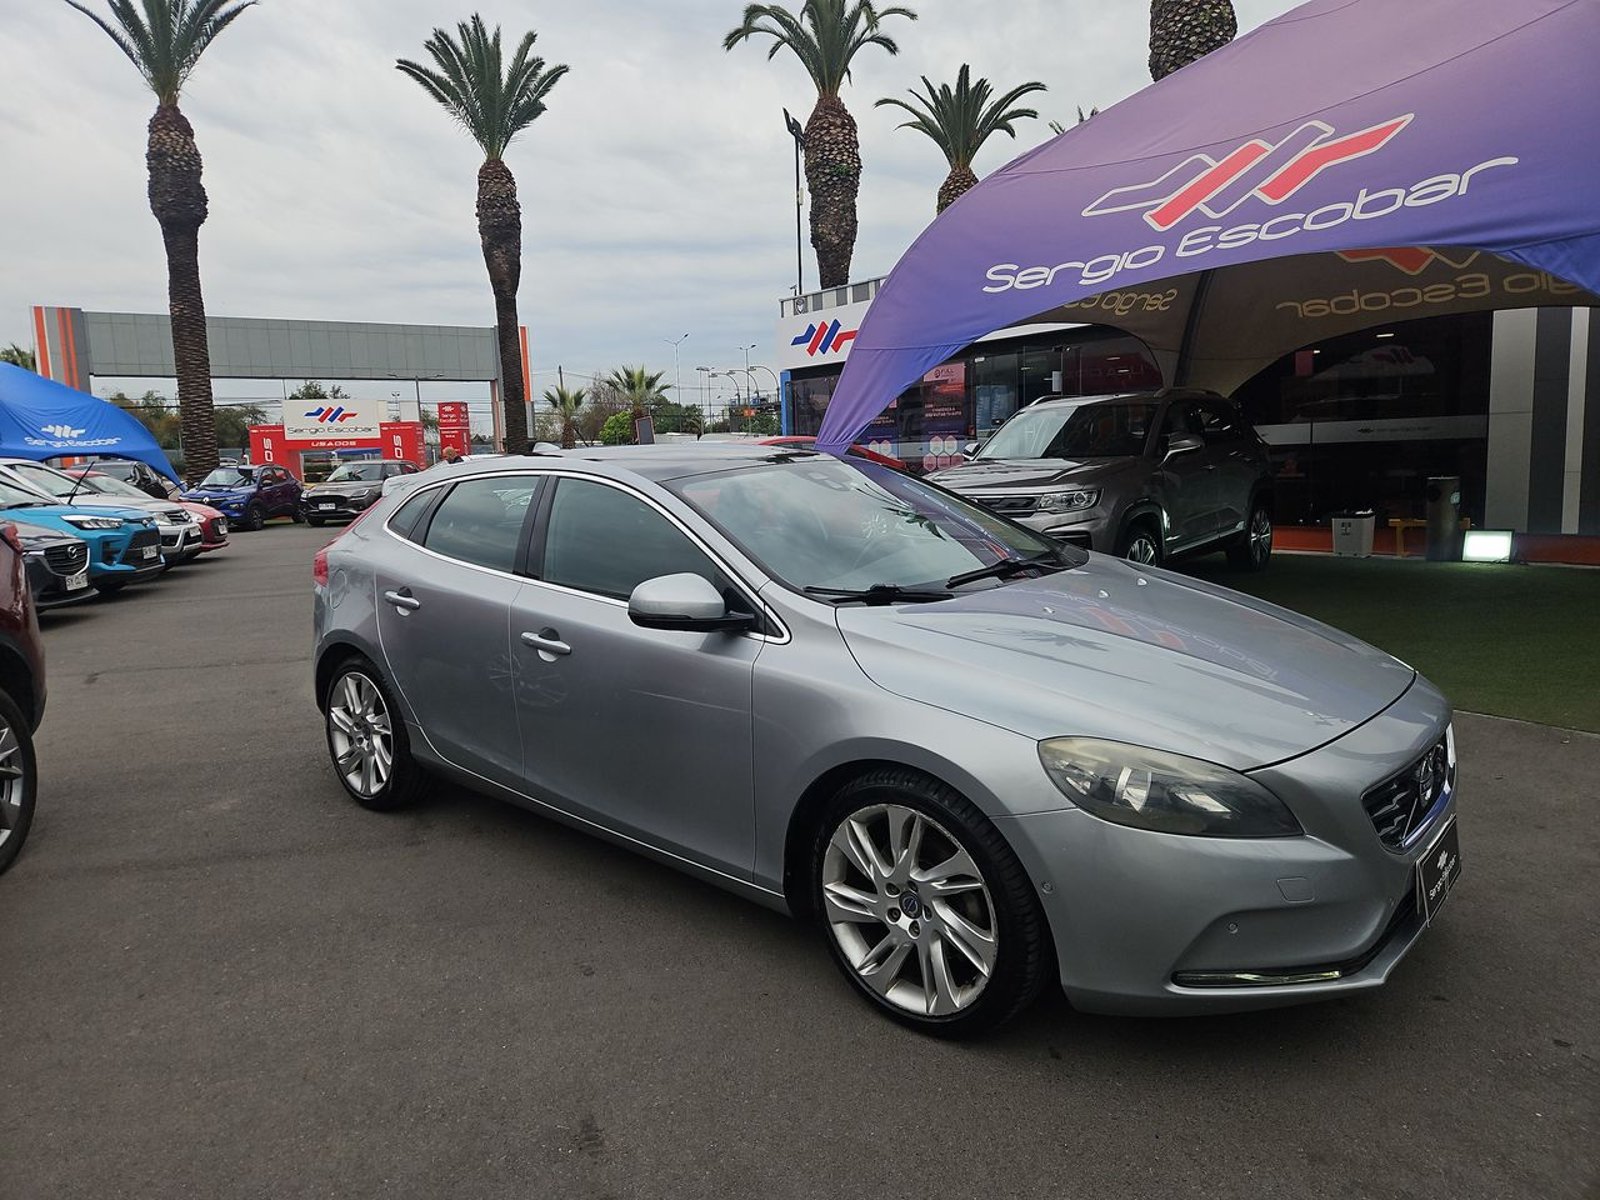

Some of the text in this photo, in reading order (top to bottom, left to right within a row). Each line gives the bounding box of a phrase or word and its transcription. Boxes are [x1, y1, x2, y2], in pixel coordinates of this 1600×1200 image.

[982, 157, 1519, 293] Sergio Escobar
[327, 425, 378, 434] Escobar
